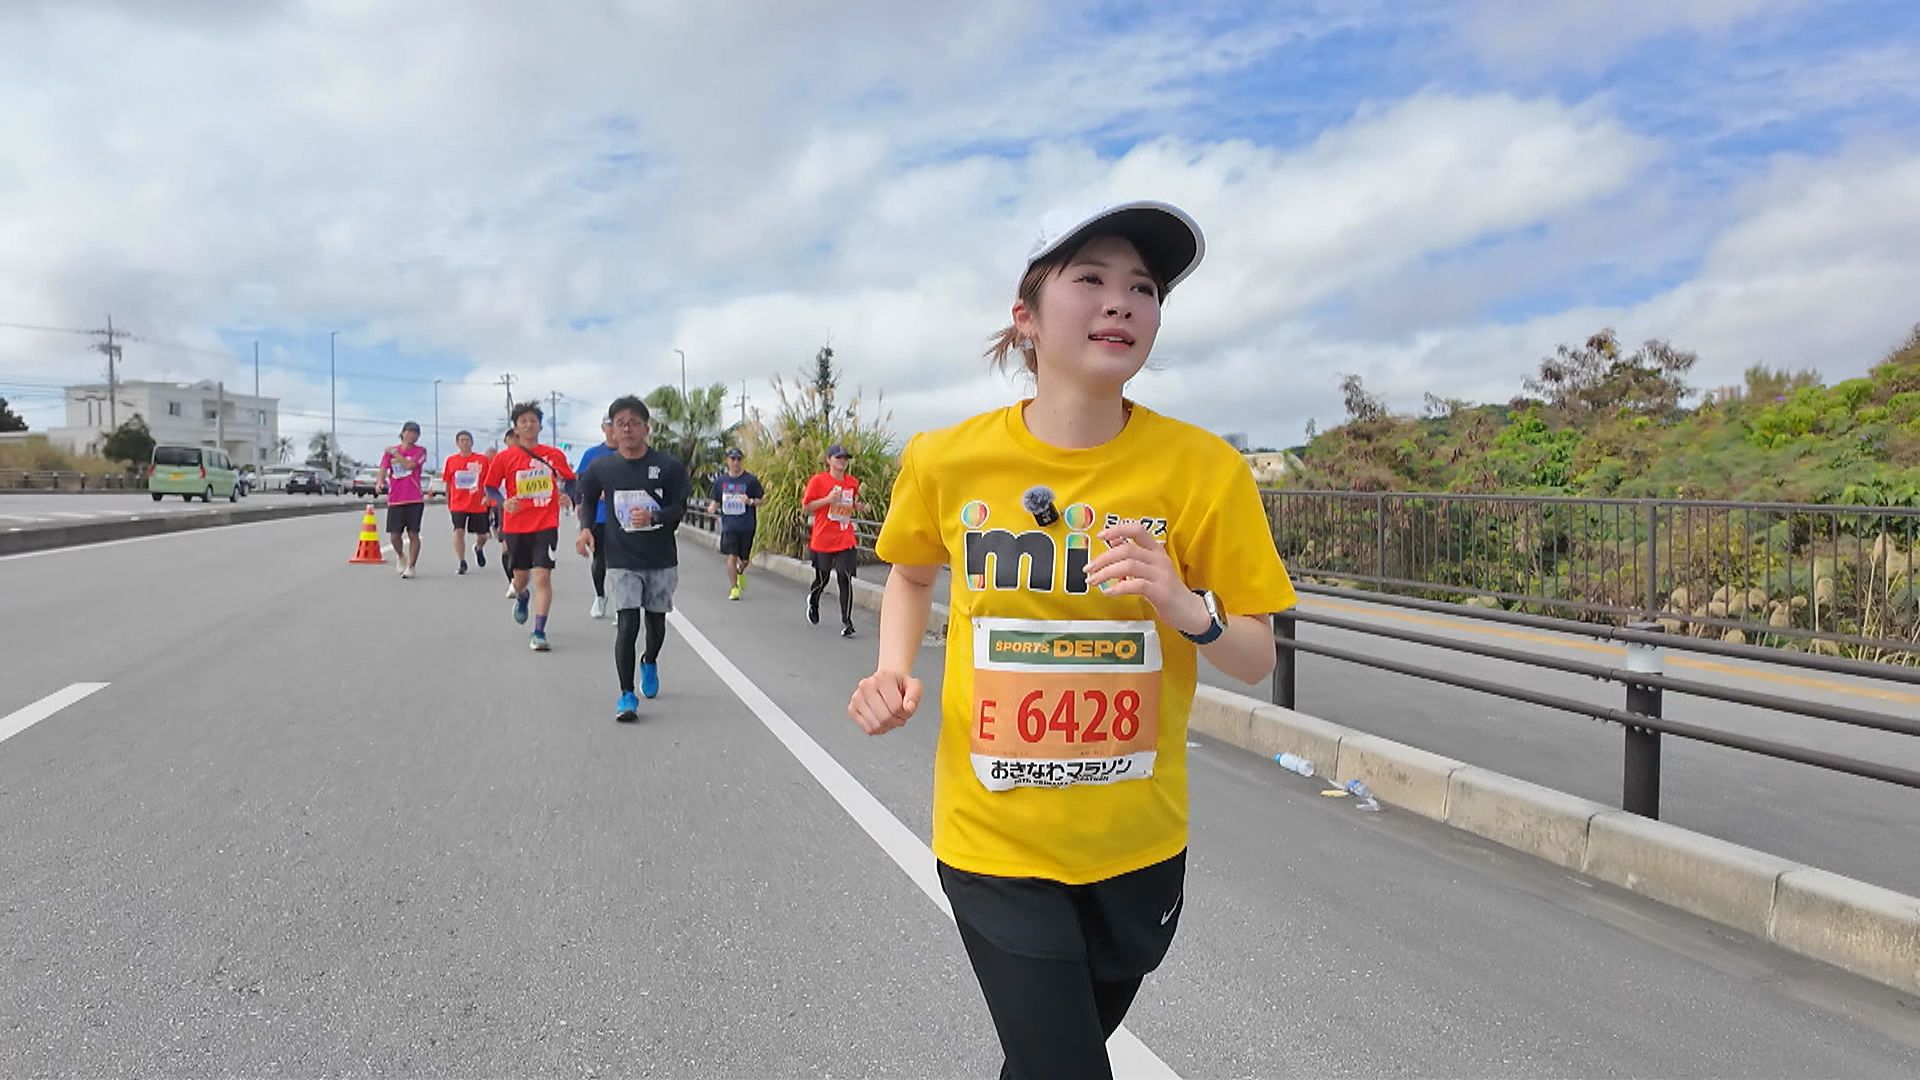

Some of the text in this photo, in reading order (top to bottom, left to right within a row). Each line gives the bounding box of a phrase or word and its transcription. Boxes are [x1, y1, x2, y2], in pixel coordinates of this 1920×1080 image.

[962, 501, 1130, 594] mi
[994, 639, 1138, 659] SPORTS DEPO
[978, 689, 1141, 743] E 6428
[990, 758, 1132, 781] おきなわマラソン
